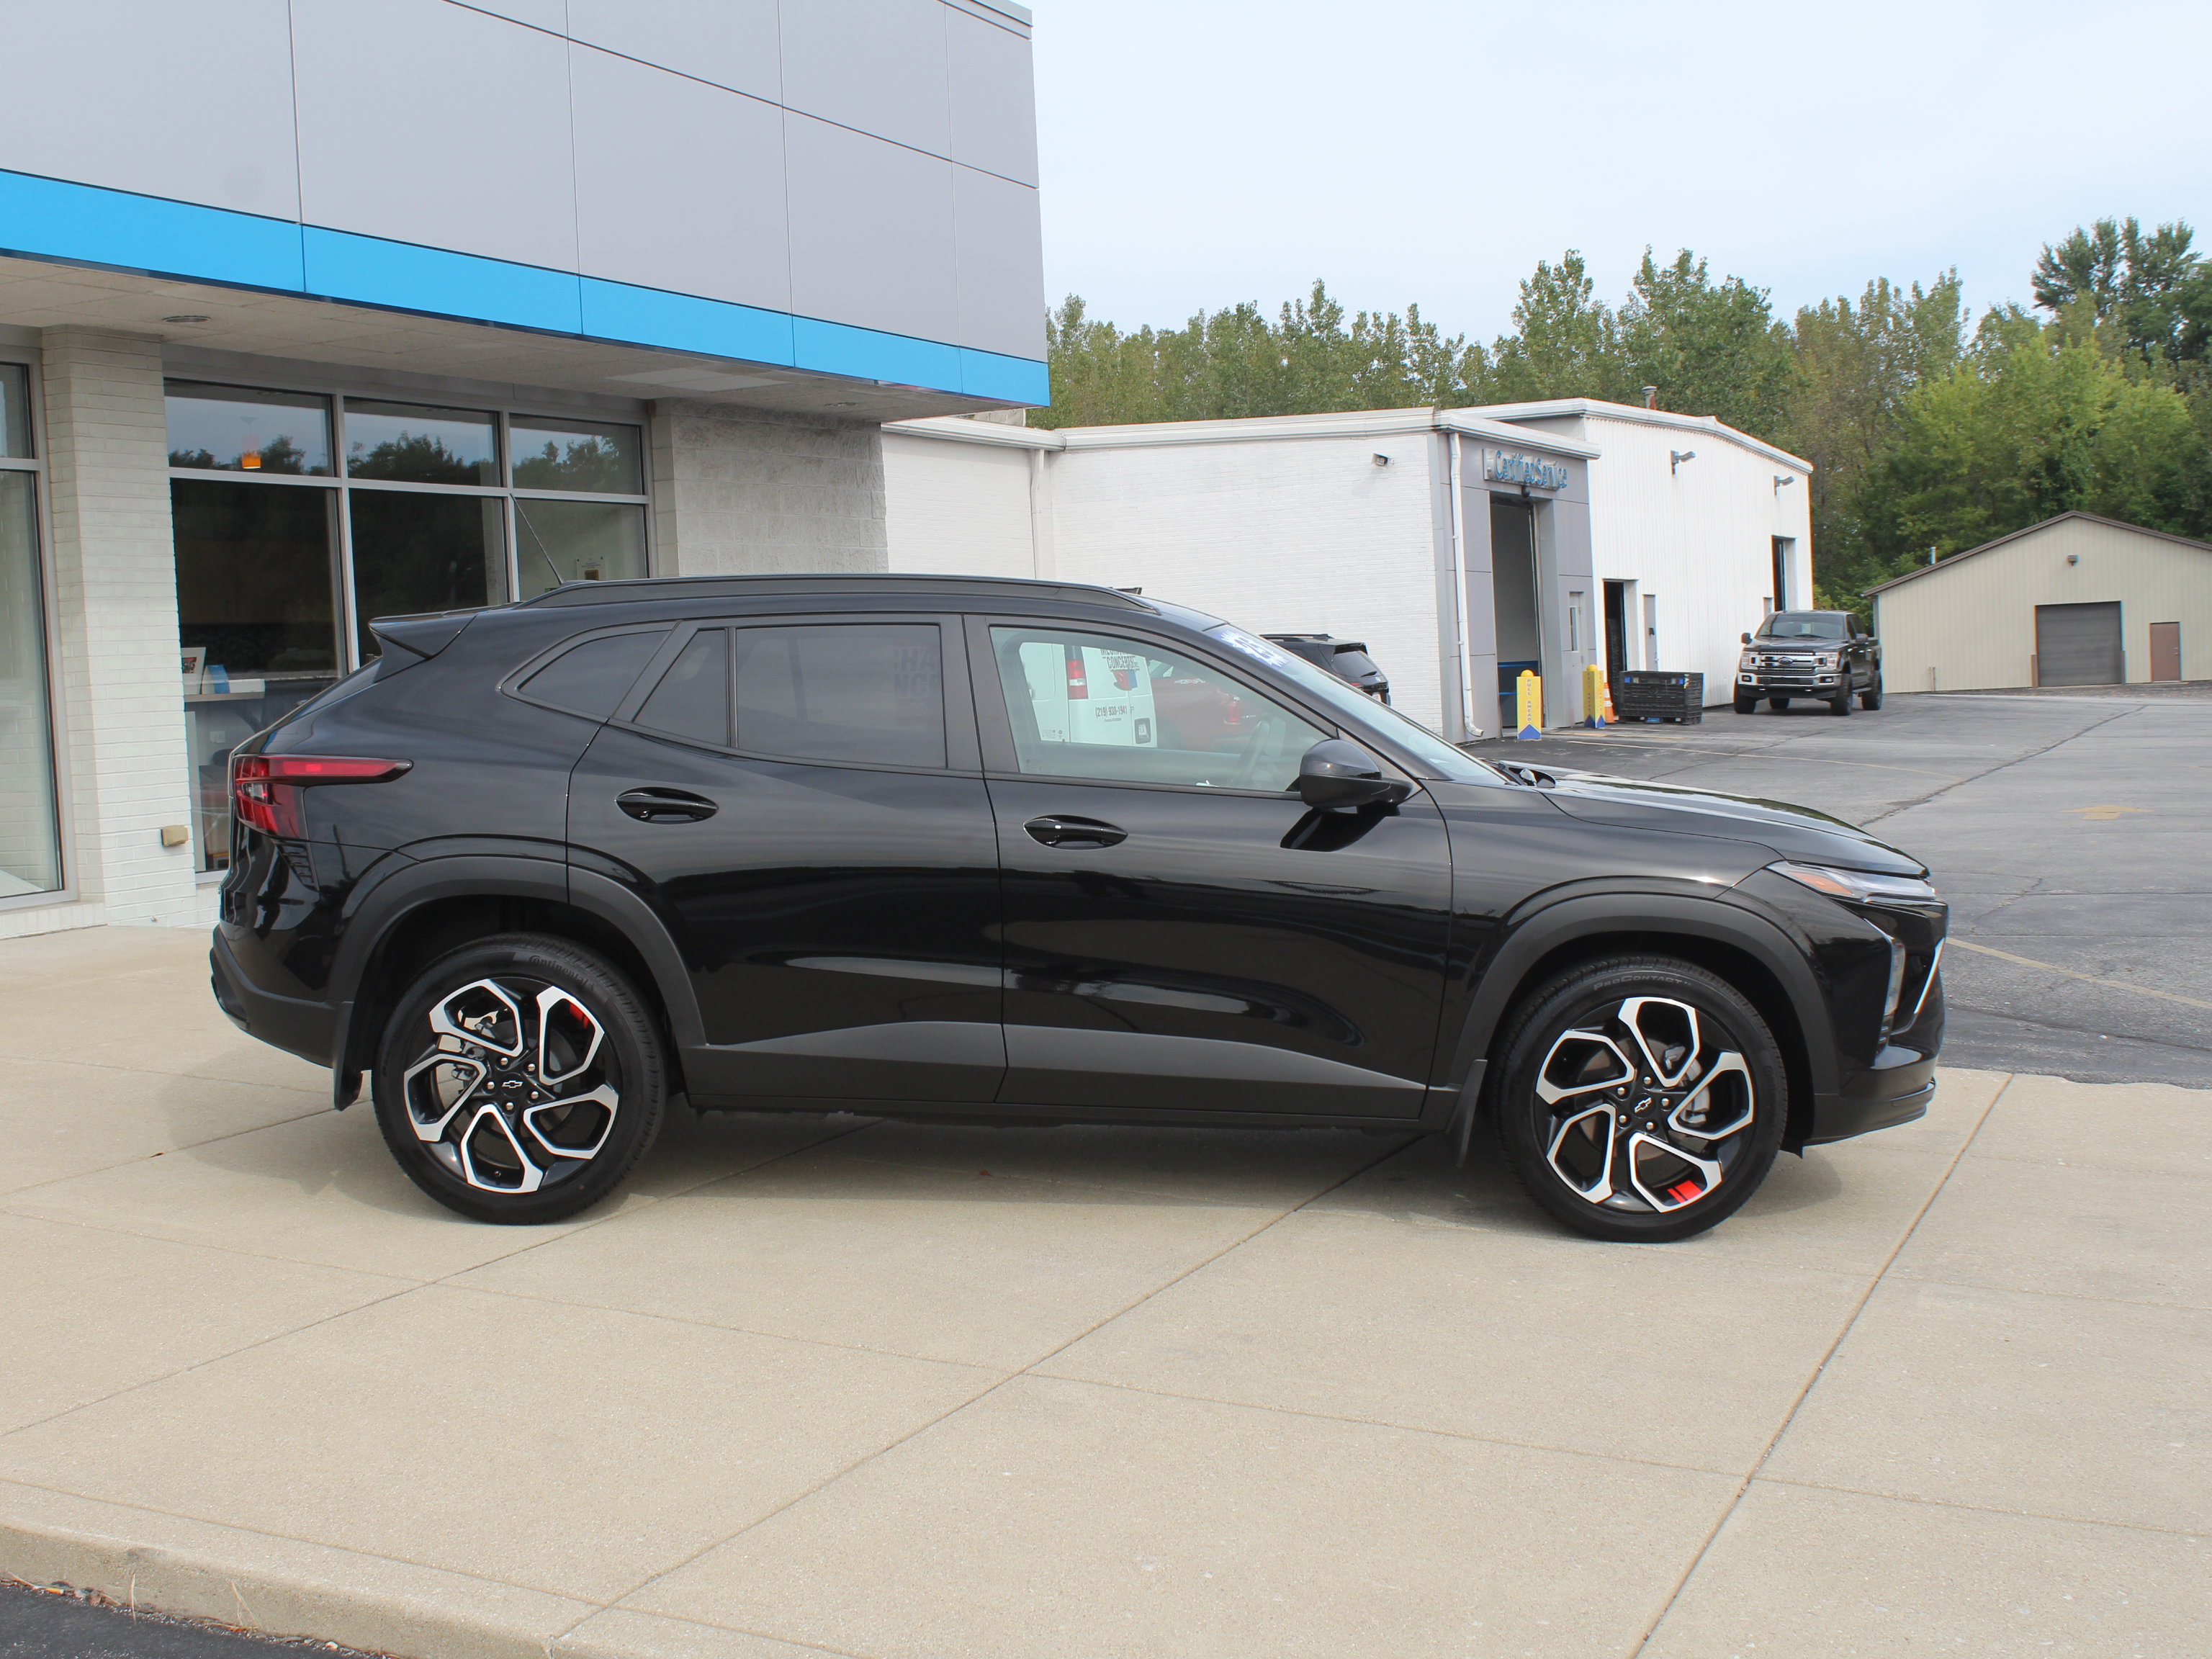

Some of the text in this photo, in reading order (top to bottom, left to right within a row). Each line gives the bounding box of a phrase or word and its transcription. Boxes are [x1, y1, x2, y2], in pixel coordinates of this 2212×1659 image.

[1495, 450, 1568, 488] Certified Service
[529, 955, 589, 986] Continental
